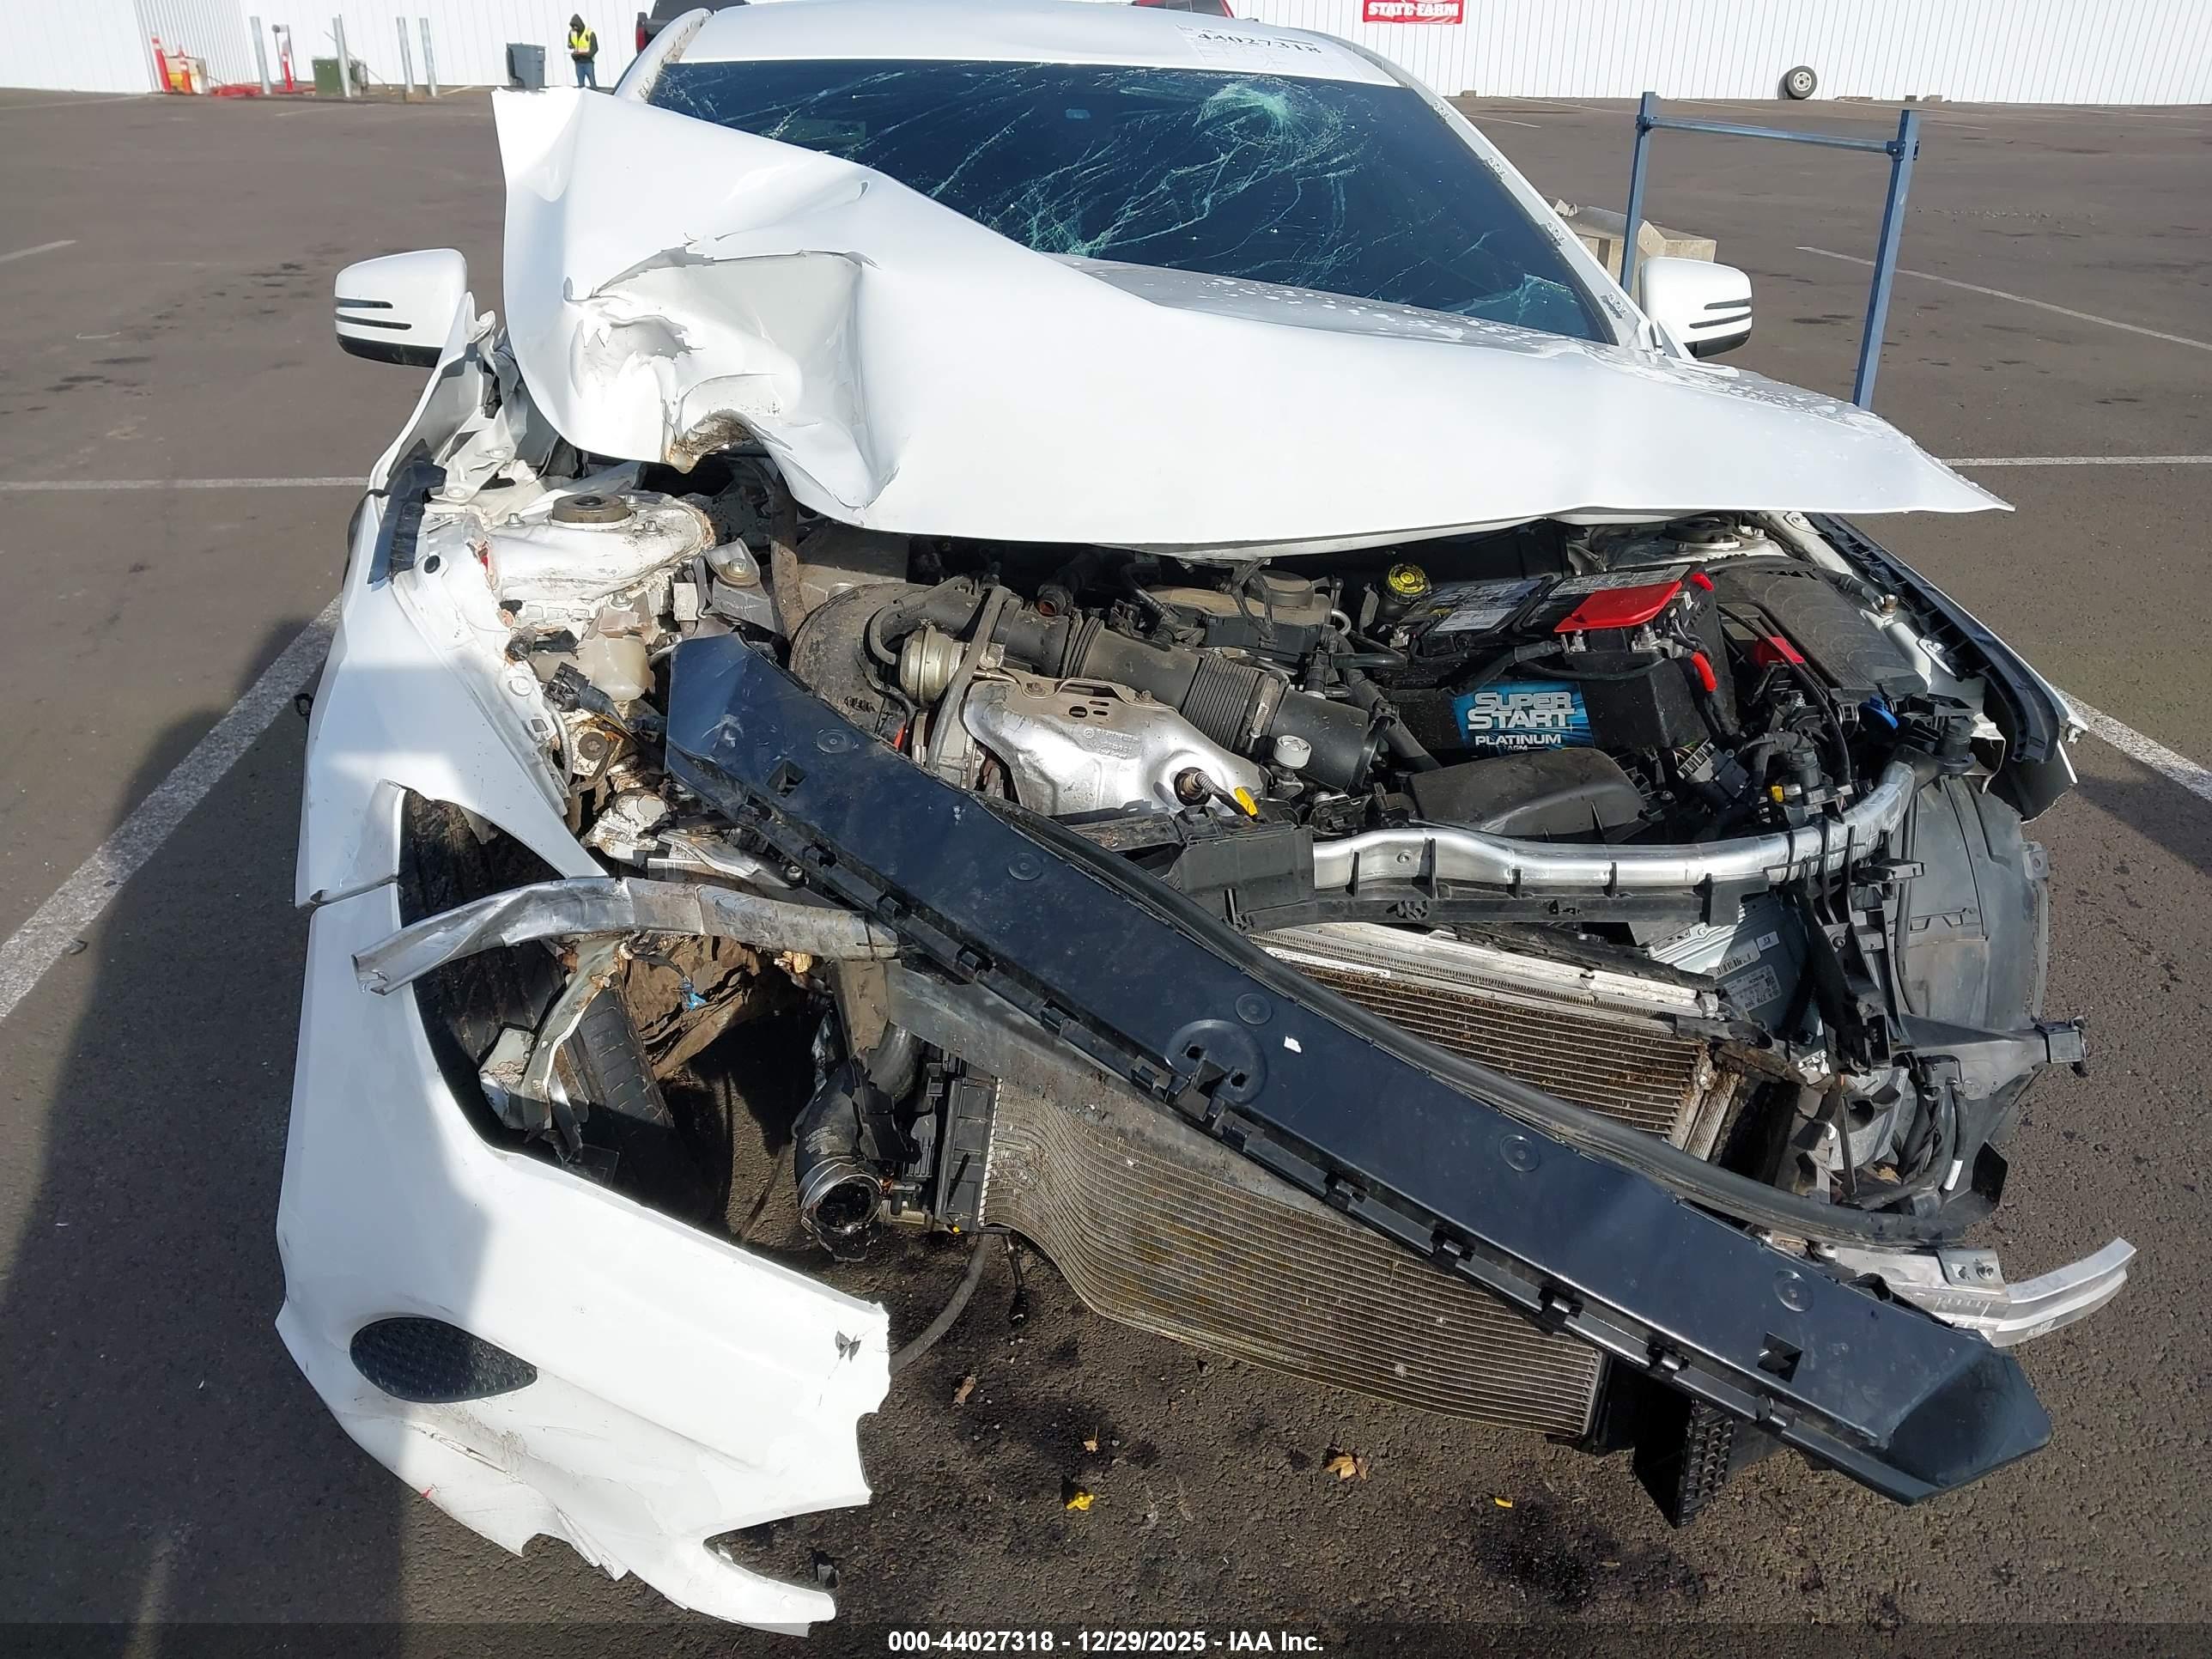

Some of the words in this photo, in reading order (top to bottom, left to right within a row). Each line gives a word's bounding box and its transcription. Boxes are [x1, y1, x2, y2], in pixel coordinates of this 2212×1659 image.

[1368, 2, 1414, 16] STATE
[1416, 3, 1460, 17] FARM
[1474, 691, 1571, 711] SUPER
[1468, 708, 1576, 730] START
[1475, 733, 1562, 746] PLATINUM
